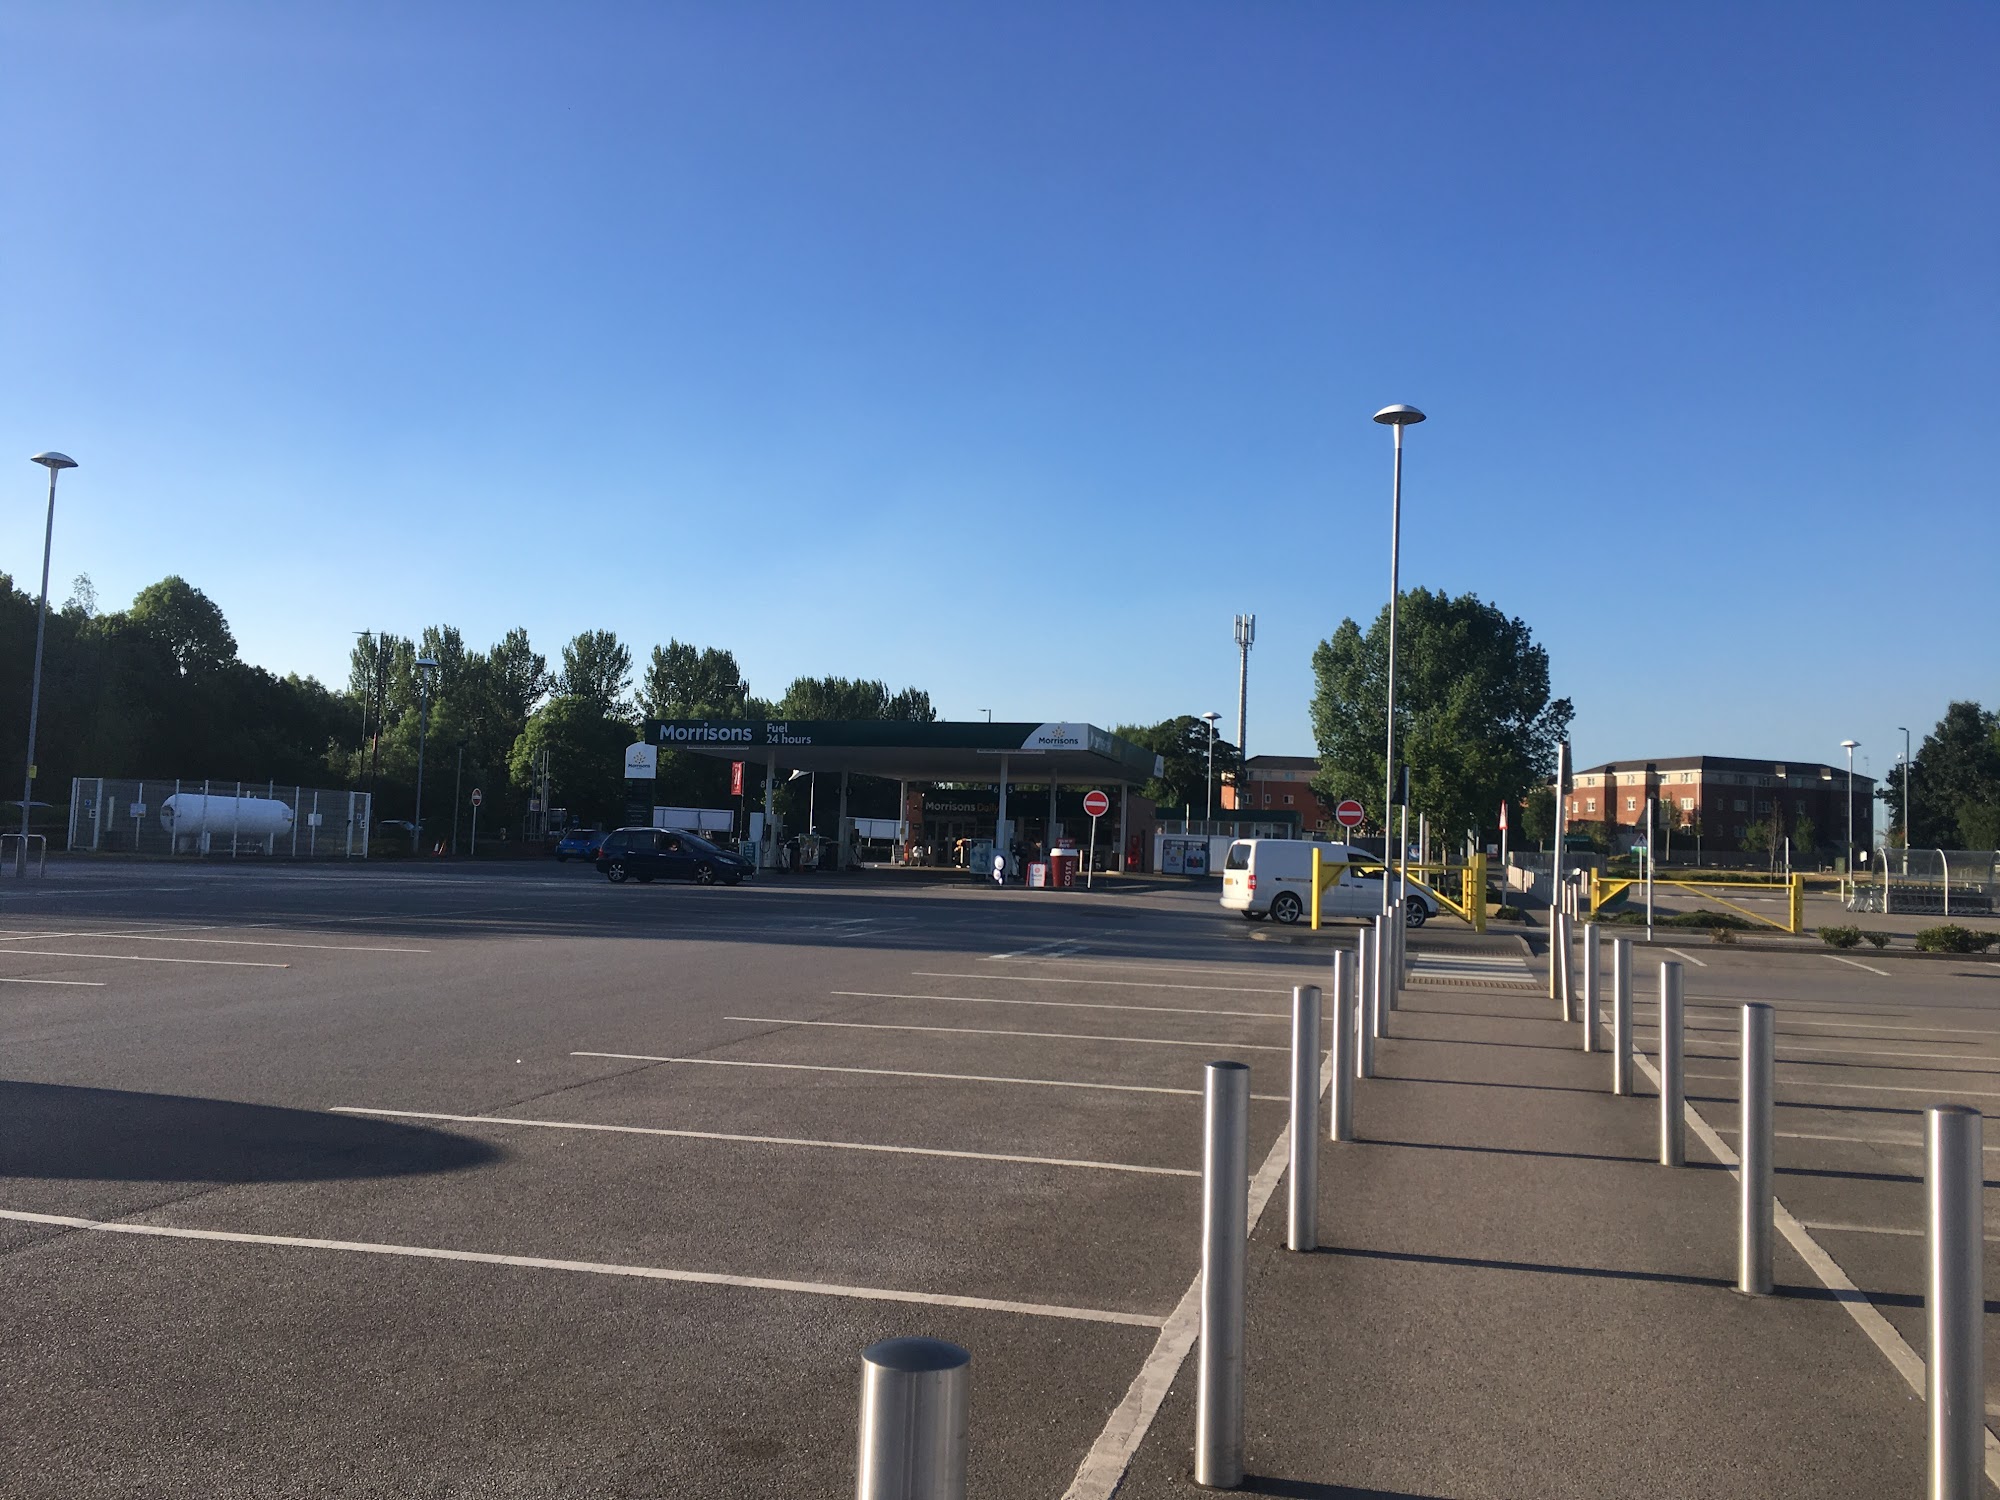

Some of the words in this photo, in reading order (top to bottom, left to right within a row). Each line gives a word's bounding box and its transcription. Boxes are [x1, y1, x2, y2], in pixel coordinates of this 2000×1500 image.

[659, 722, 753, 741] Morrisons
[766, 723, 788, 733] Fuel
[766, 734, 779, 744] 24
[781, 733, 812, 744] hours
[1038, 736, 1079, 745] Morrisons
[760, 780, 766, 789] 8
[774, 780, 780, 789] 7
[993, 785, 999, 794] 6
[1008, 785, 1013, 794] 5
[925, 801, 976, 812] Morrisons
[976, 802, 999, 814] Daily
[1064, 861, 1072, 886] COSTA
